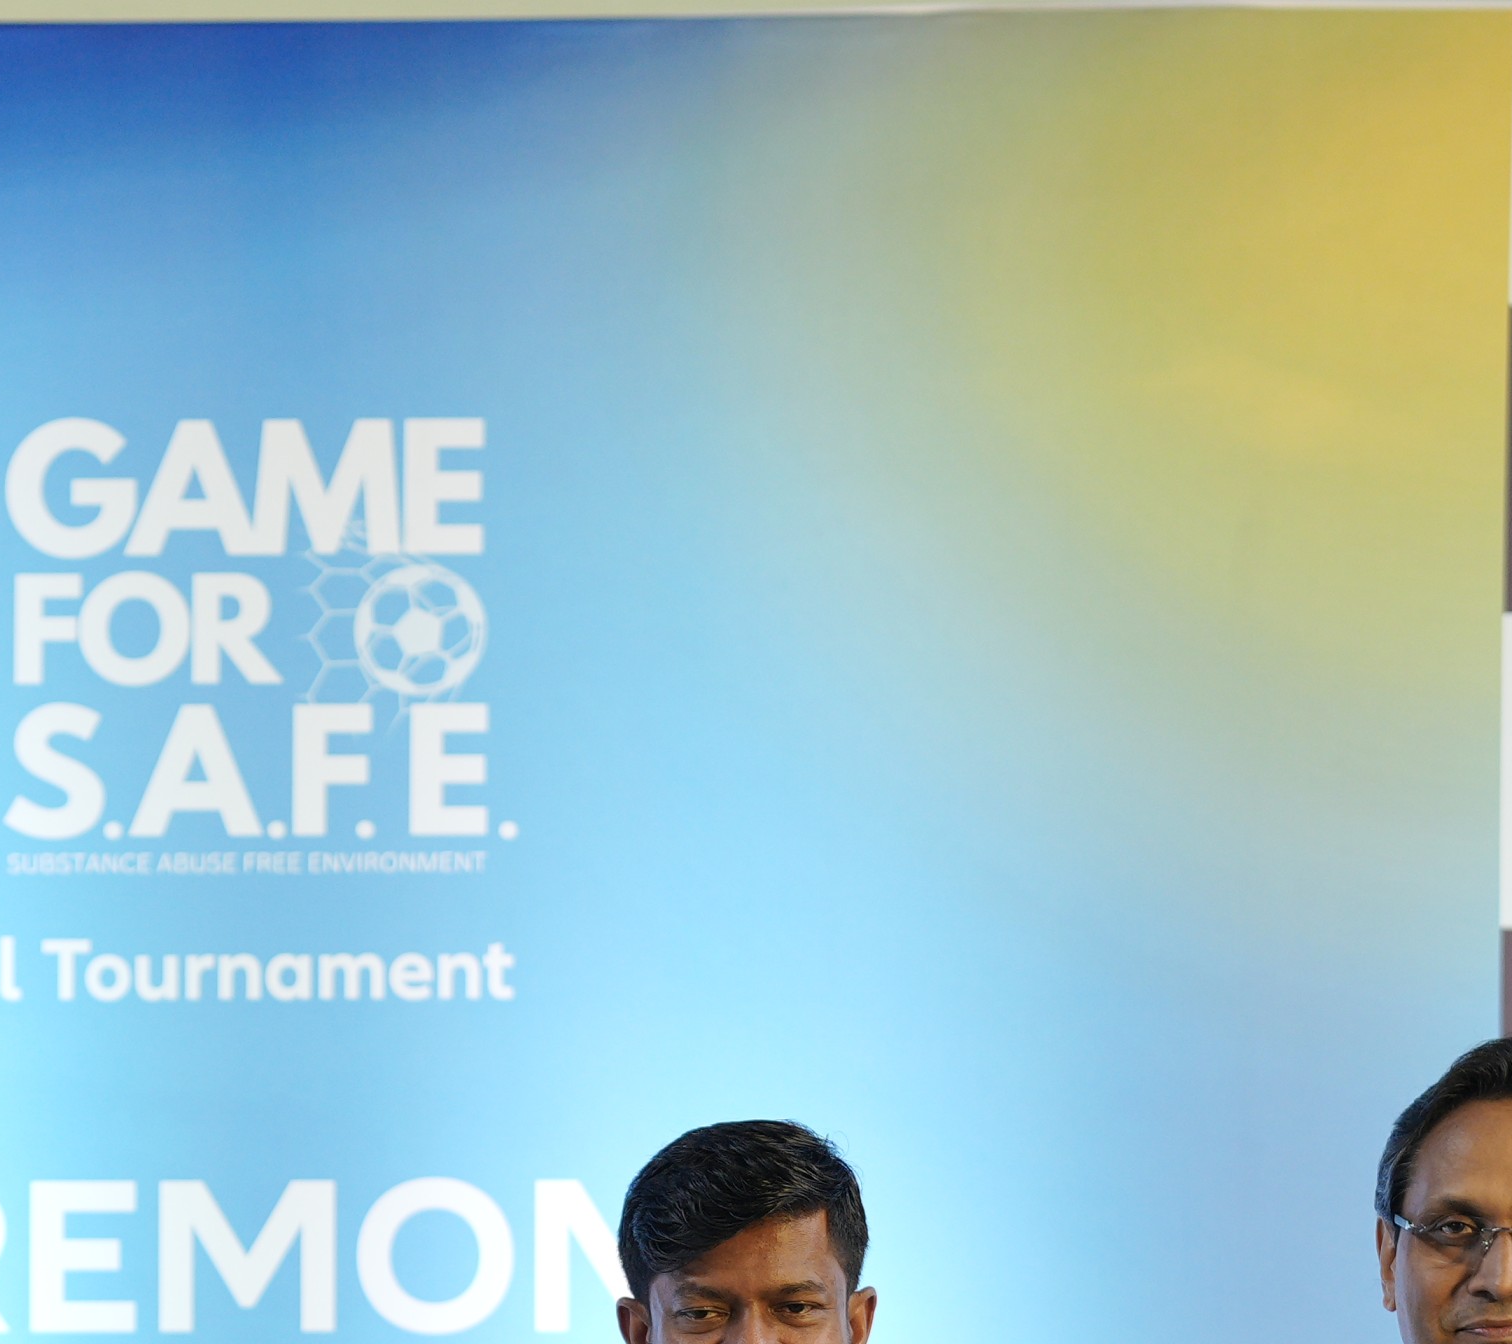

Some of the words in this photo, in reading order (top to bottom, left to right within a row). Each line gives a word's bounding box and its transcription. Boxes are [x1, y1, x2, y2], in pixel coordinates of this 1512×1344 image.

[4, 415, 487, 560] GAME
[13, 570, 283, 688] FOR
[2, 701, 521, 841] S.A.F.E.
[6, 851, 150, 876] SUBSTANCE
[156, 851, 237, 875] ABUSE
[243, 851, 300, 875] FREE
[308, 850, 489, 875] ENVIRONMENT
[41, 939, 517, 1003] Tournament
